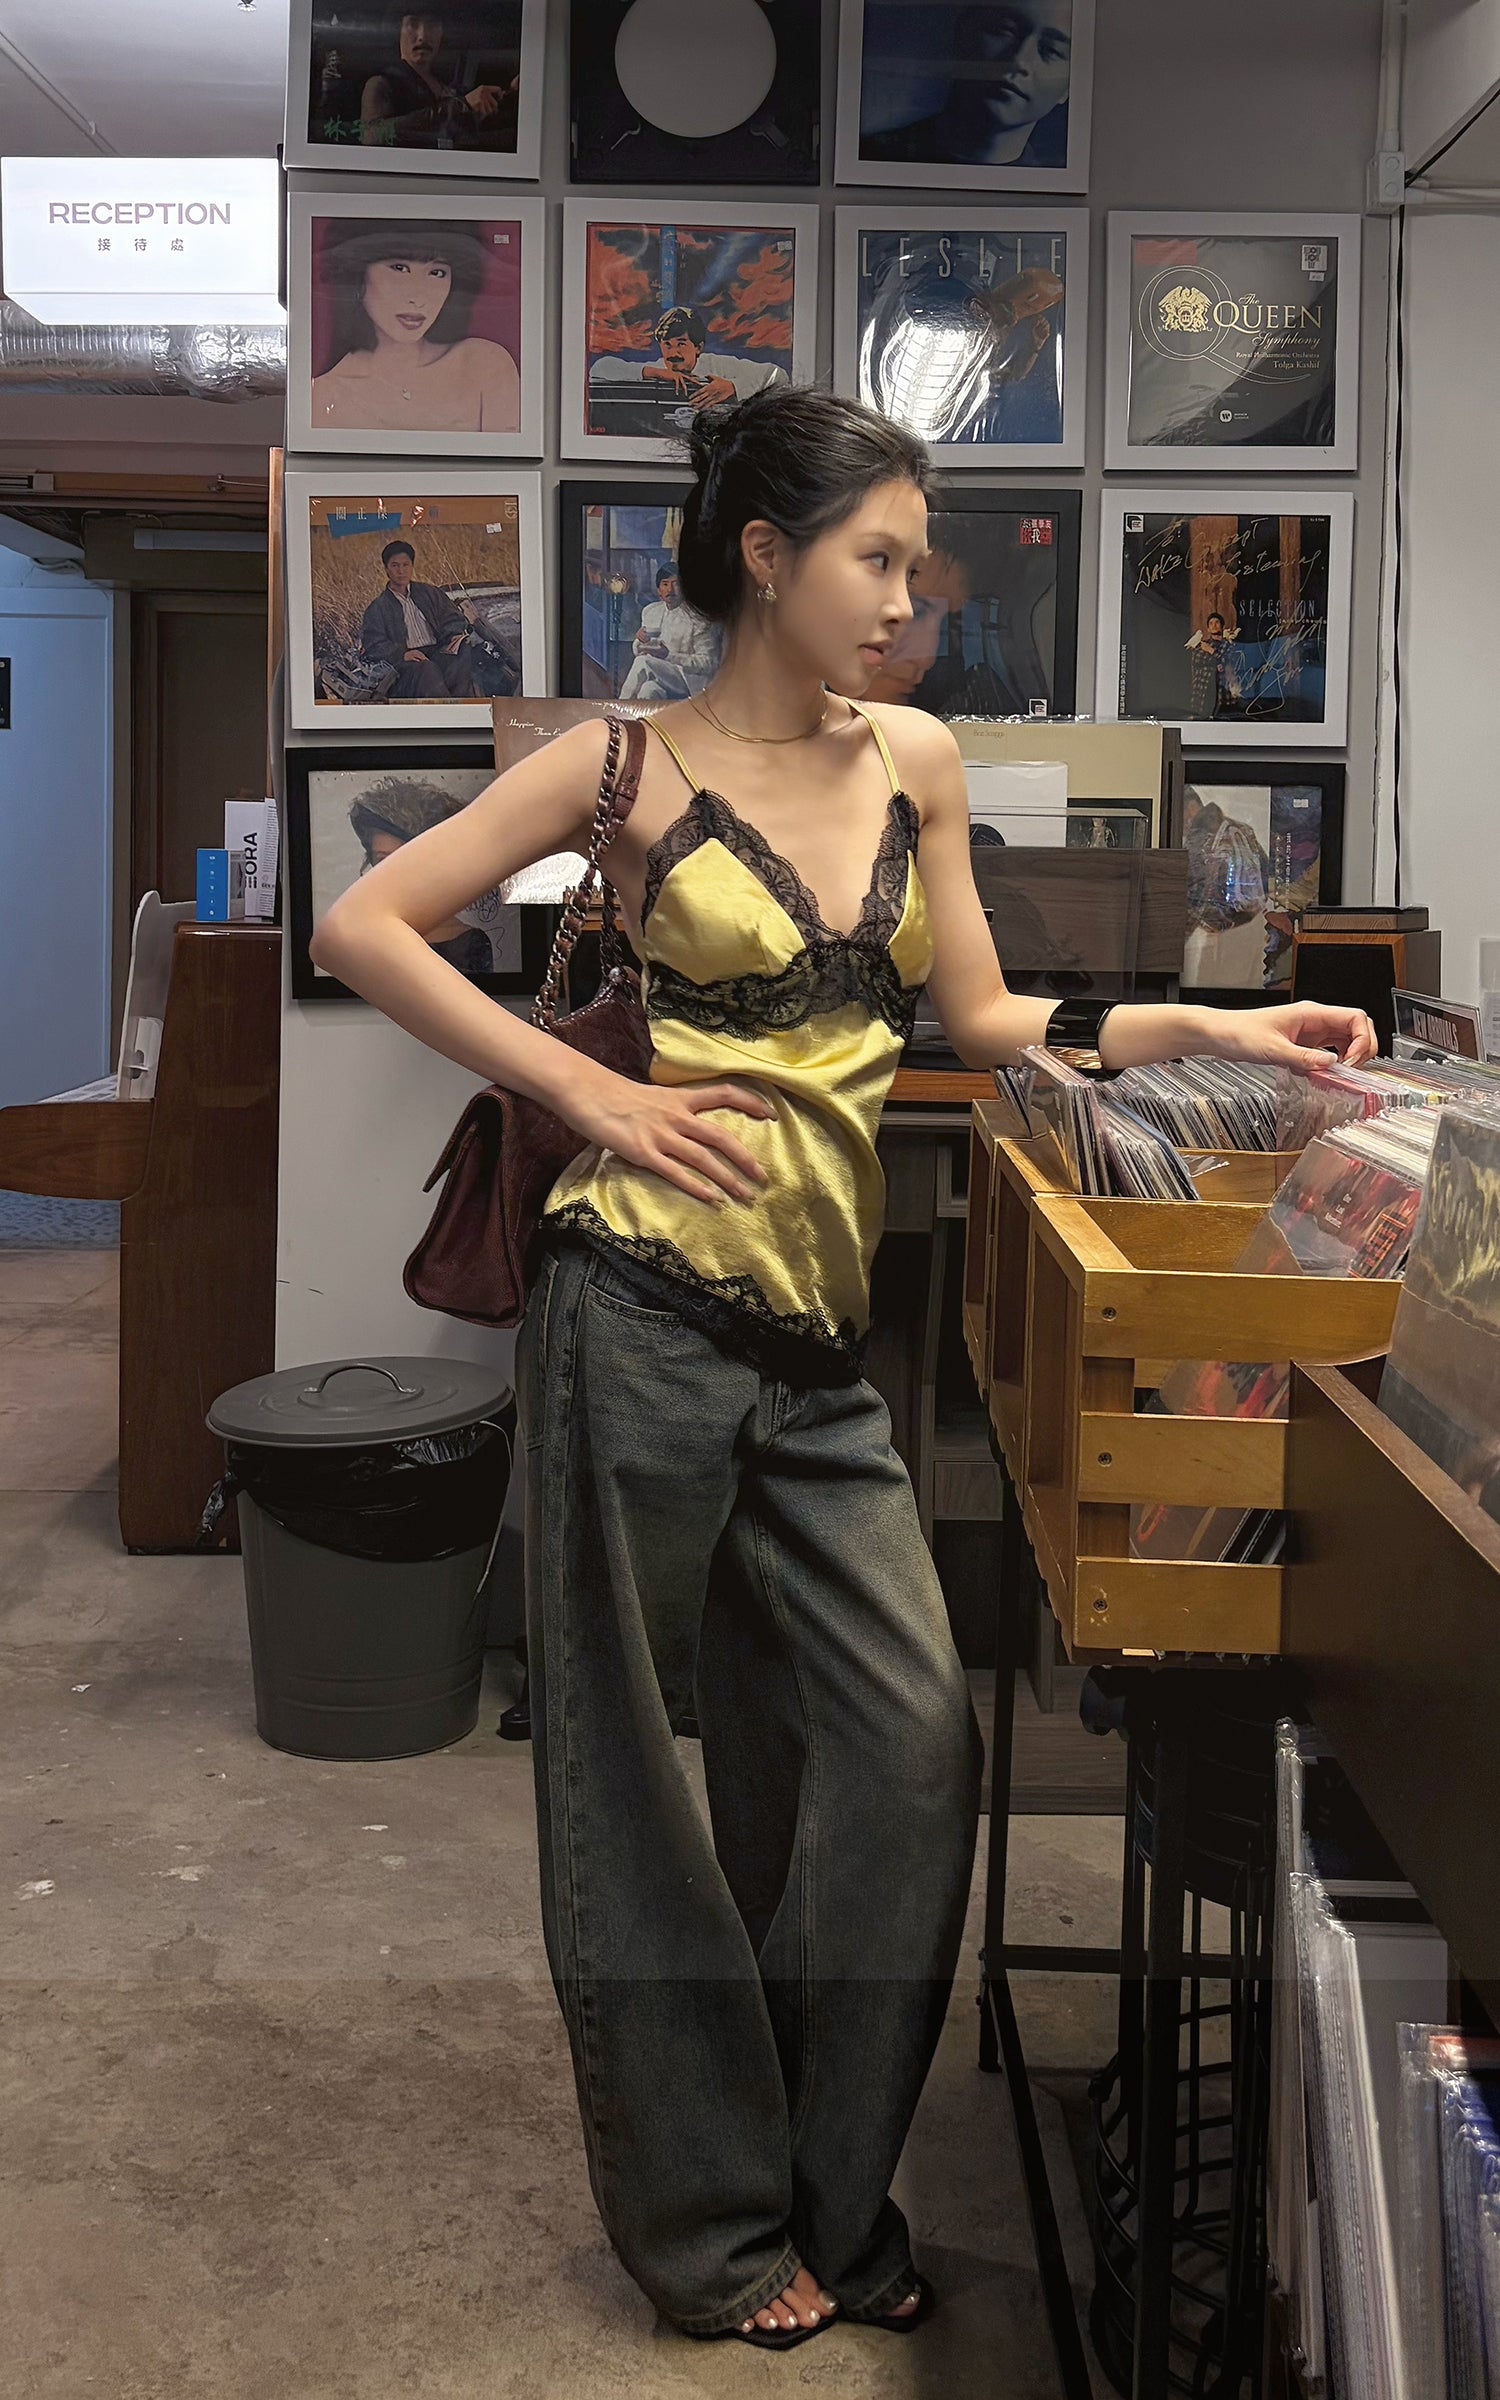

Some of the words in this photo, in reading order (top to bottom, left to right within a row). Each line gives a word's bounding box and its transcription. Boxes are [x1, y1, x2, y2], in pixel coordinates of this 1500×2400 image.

[49, 202, 231, 224] RECEPTION
[98, 238, 184, 251] 接待處
[862, 238, 1062, 277] LESLIE
[1238, 293, 1260, 305] The
[1212, 300, 1321, 334] QUEEN
[1252, 331, 1320, 349] Symphony
[1272, 361, 1294, 370] Tolga
[1239, 600, 1315, 618] SELECTION
[505, 718, 535, 729] Happier
